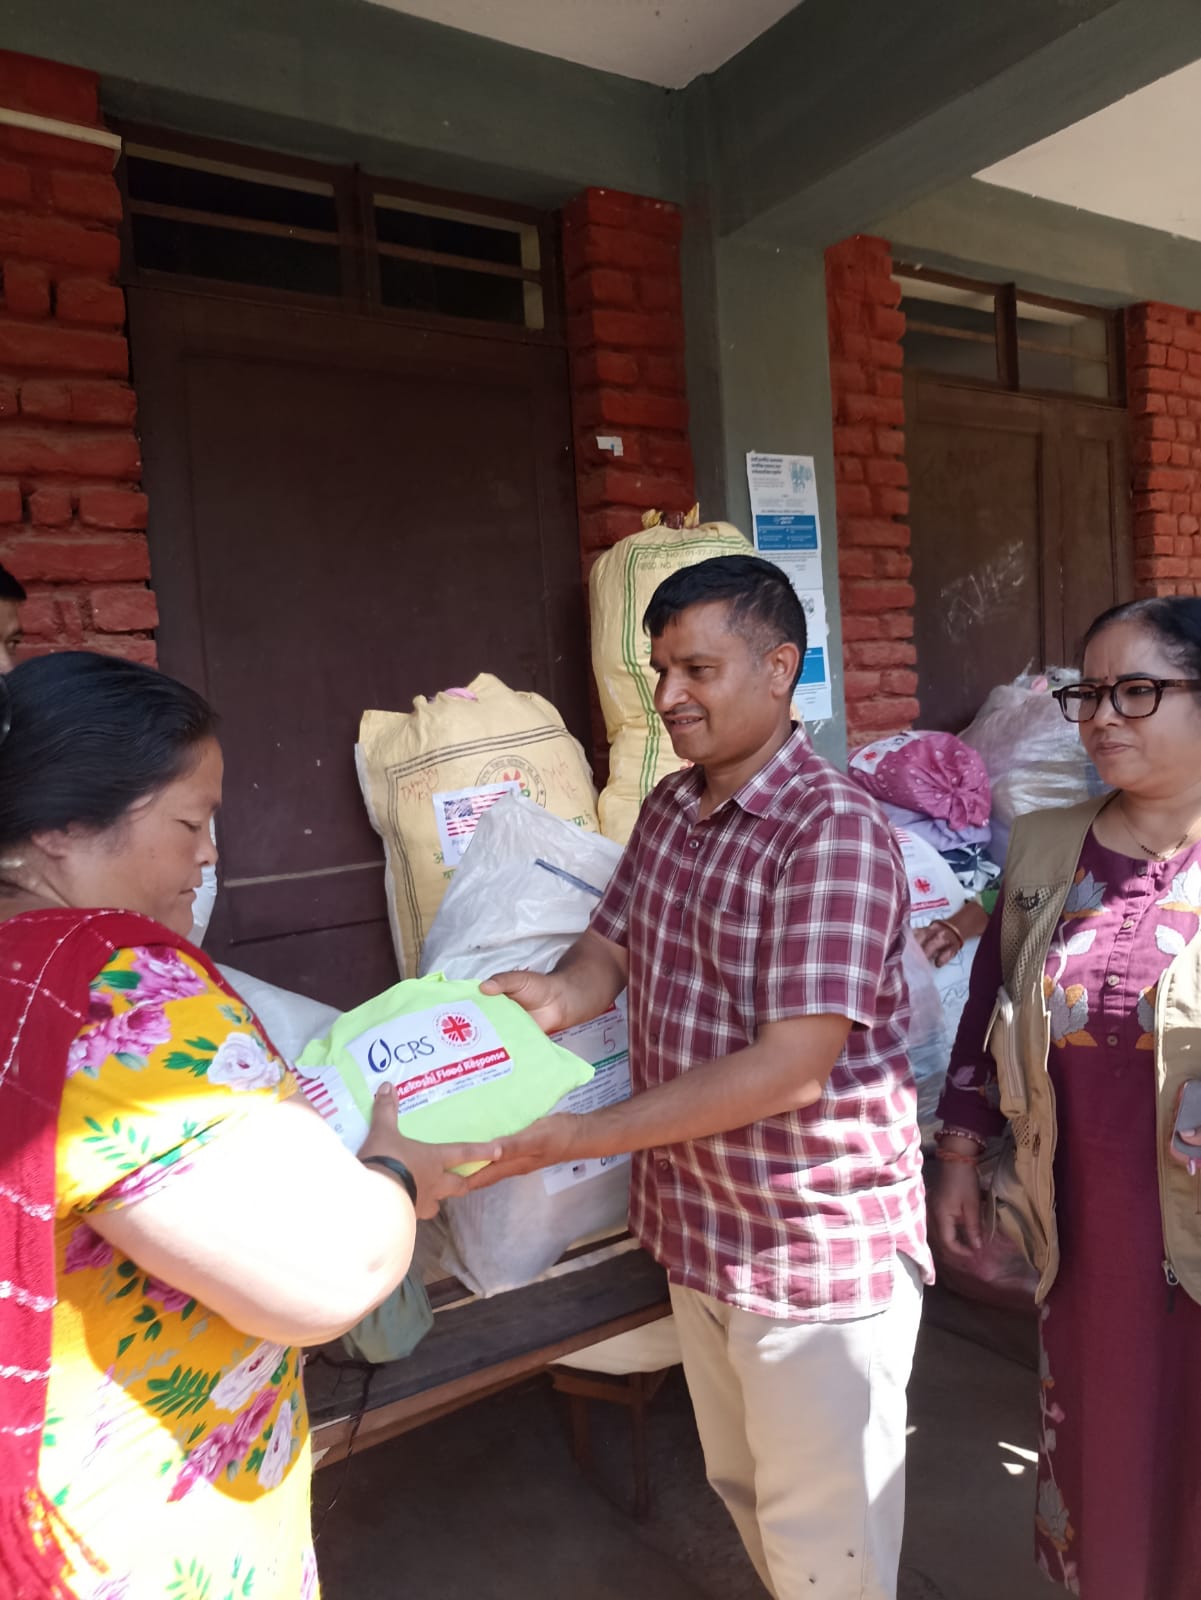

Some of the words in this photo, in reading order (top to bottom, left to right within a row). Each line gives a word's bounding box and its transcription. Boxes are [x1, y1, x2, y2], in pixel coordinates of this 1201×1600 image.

[394, 1035, 435, 1064] CRS
[602, 1027, 616, 1053] 5
[435, 1064, 464, 1082] Flood
[463, 1050, 506, 1071] Response
